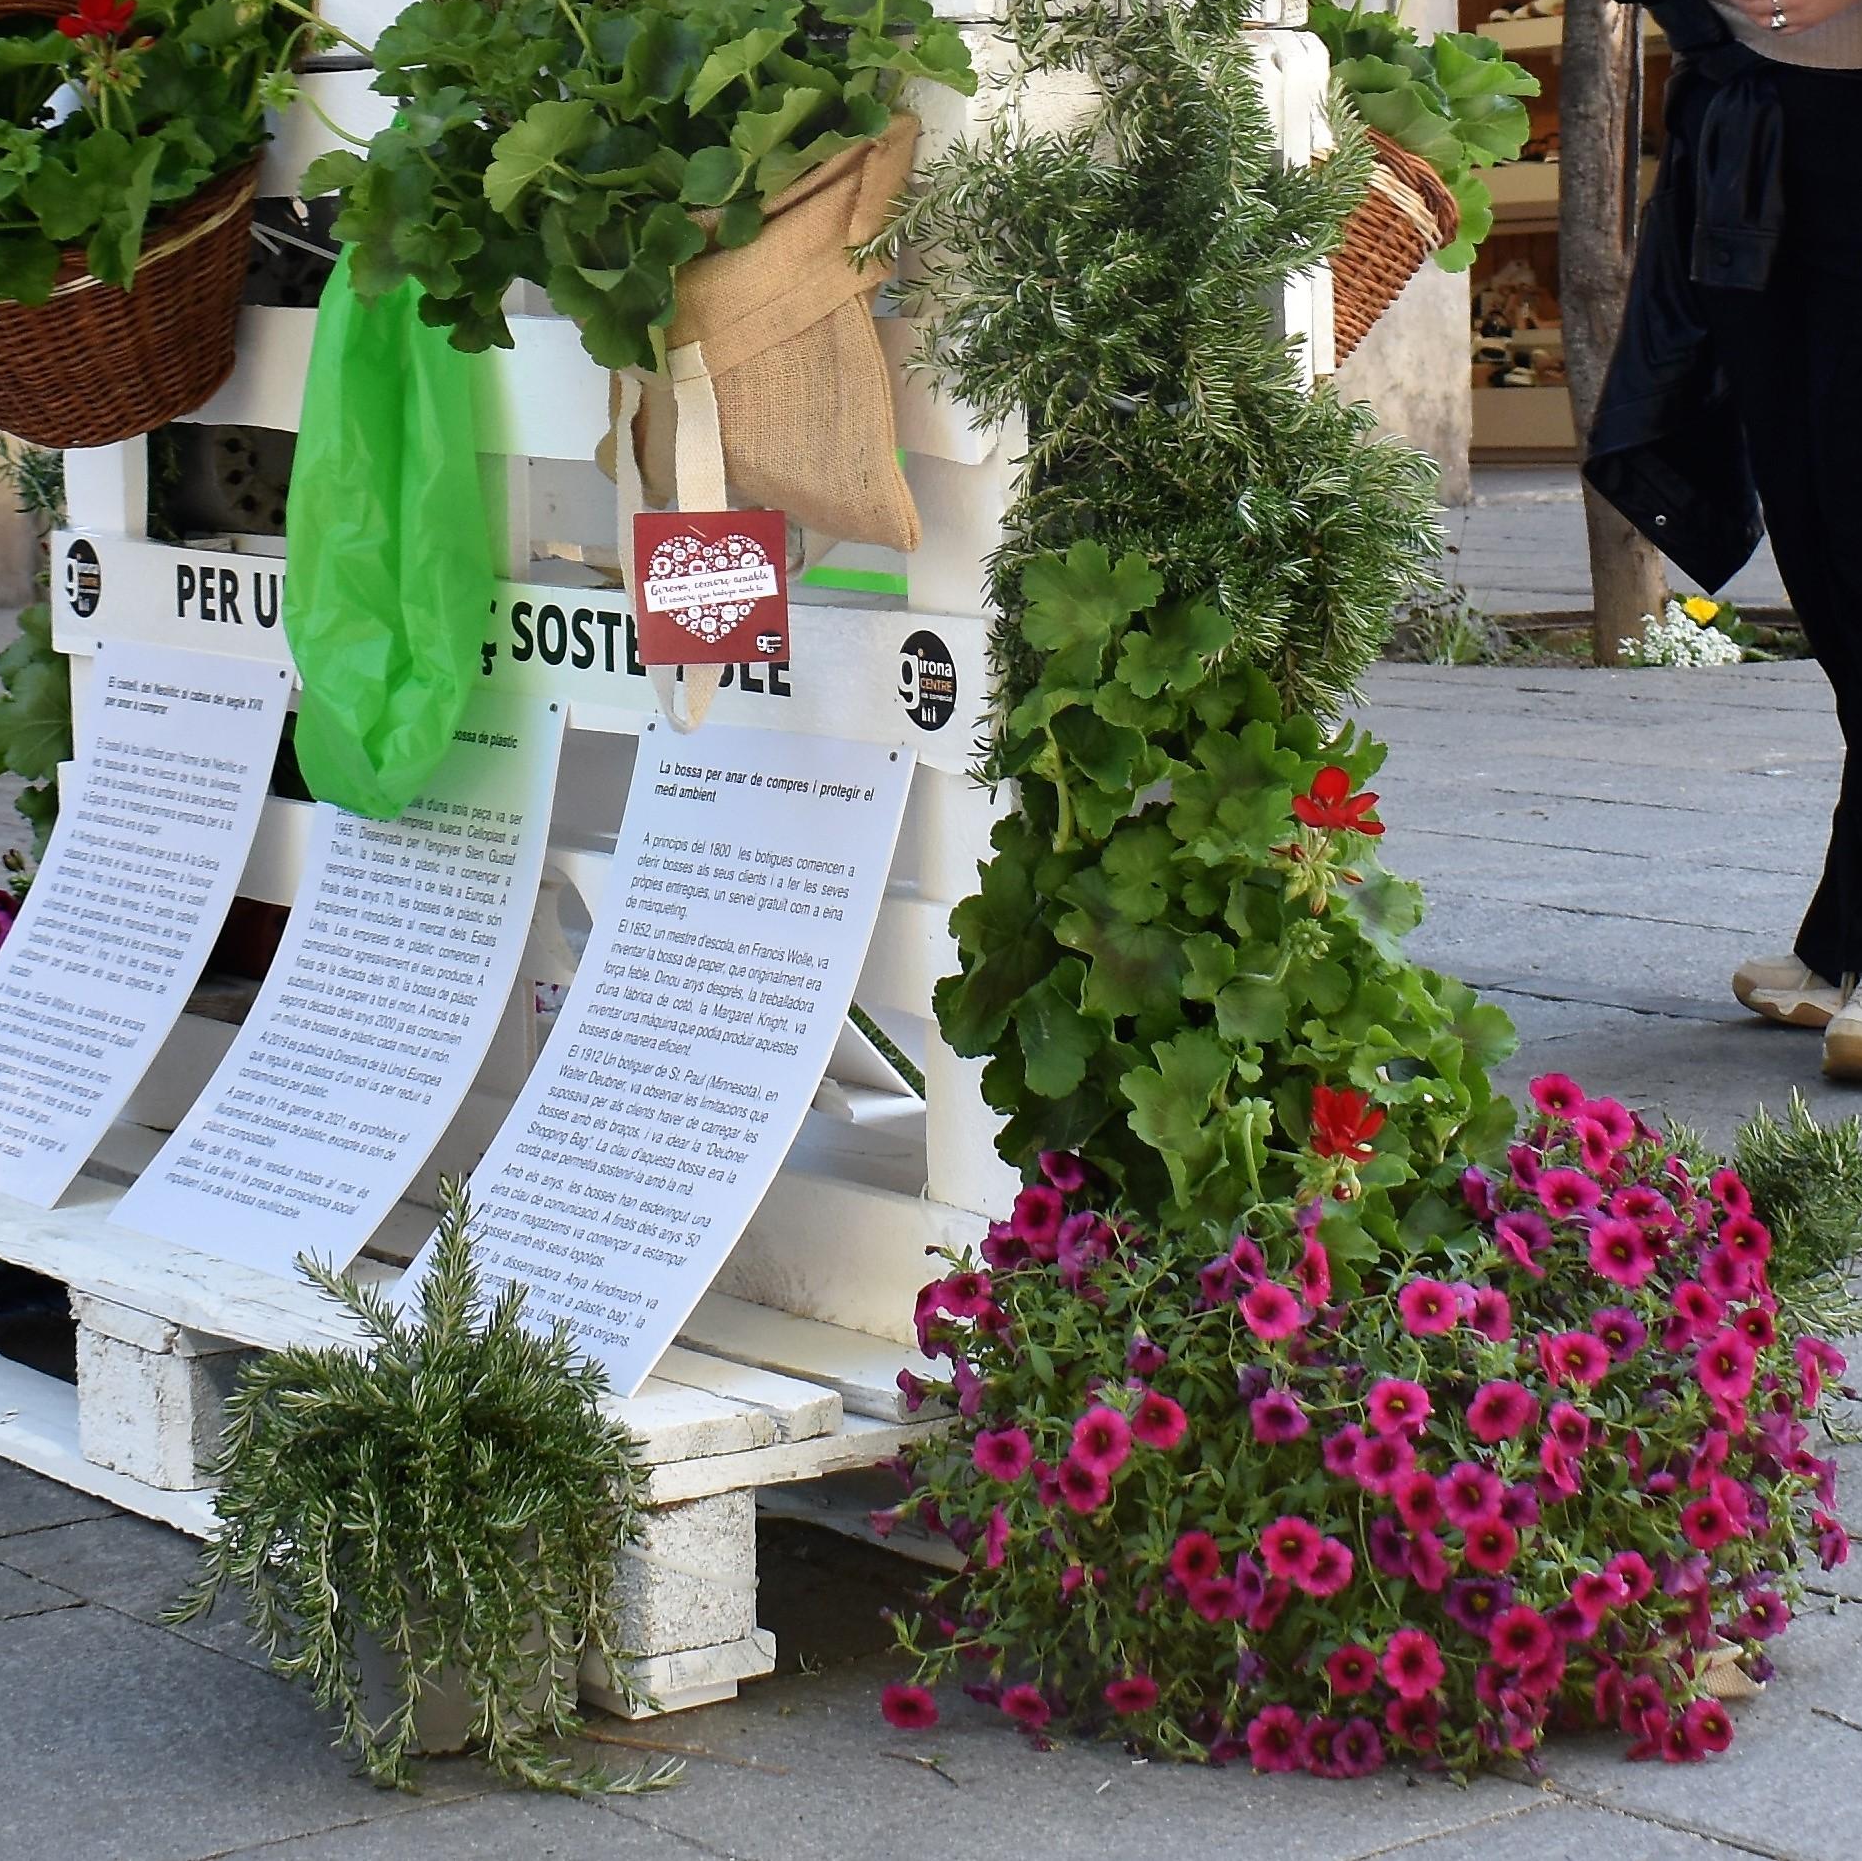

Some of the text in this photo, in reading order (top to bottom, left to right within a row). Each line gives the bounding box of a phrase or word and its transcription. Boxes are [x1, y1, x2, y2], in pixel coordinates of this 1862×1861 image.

[175, 563, 243, 625] PER
[920, 677, 953, 693] CENTRE
[654, 783, 716, 802] medi ambient
[659, 760, 875, 802] La bossa per anar de compres i protegir el
[637, 853, 849, 899] oferir bosses als seus clients a fer les seves
[643, 832, 650, 845] A
[691, 839, 706, 854] del
[710, 842, 731, 858] 1800
[737, 846, 752, 861] les
[755, 849, 793, 868] botigues
[796, 858, 845, 875] comencen
[848, 866, 855, 877] a
[625, 895, 637, 909] de
[714, 890, 726, 901] un
[728, 892, 756, 906] servei
[790, 902, 810, 915] com
[813, 906, 820, 917] a
[823, 907, 843, 921] eina
[611, 943, 646, 958] inventar
[646, 946, 656, 961] la
[656, 949, 683, 966] bossa
[684, 954, 697, 968] de
[728, 965, 747, 978] que
[806, 978, 822, 991] era
[618, 919, 629, 933] El
[653, 929, 666, 940] un
[666, 931, 697, 946] mestre
[737, 943, 750, 955] en
[751, 943, 785, 961] Francis
[817, 957, 829, 970] va
[603, 960, 626, 978] força
[654, 970, 681, 987] Dinou
[682, 978, 705, 994] anys
[747, 987, 757, 1002] la
[760, 992, 814, 1013] treballadora
[579, 1021, 610, 1039] bosses
[610, 1028, 623, 1042] de
[623, 1033, 657, 1049] manera
[656, 993, 669, 1007] de
[699, 1001, 708, 1015] la
[712, 1003, 754, 1024] Margaret
[795, 1023, 807, 1035] va
[559, 1064, 588, 1081] Walter
[630, 1082, 642, 1095] va
[643, 1085, 683, 1103] observar
[683, 1092, 699, 1107] les
[749, 1110, 769, 1124] que
[568, 1044, 580, 1058] El
[580, 1047, 603, 1063] 1912
[602, 1052, 618, 1066] Un
[617, 1055, 654, 1075] botiguer
[654, 1064, 668, 1078] de
[683, 1069, 707, 1086] Paul
[765, 1090, 779, 1102] en
[538, 1103, 569, 1121] bosses
[570, 1113, 592, 1126] amb
[593, 1117, 608, 1130] els
[651, 1132, 664, 1144] va
[665, 1133, 690, 1149] idear
[691, 1138, 702, 1153] la
[548, 1086, 759, 1144] suposava per als clients haver de carregar les
[527, 1121, 569, 1145] Shopping
[595, 1138, 609, 1153] La
[609, 1142, 630, 1158] clau
[677, 1159, 706, 1177] bossa
[707, 1168, 725, 1182] era
[726, 1170, 737, 1184] la
